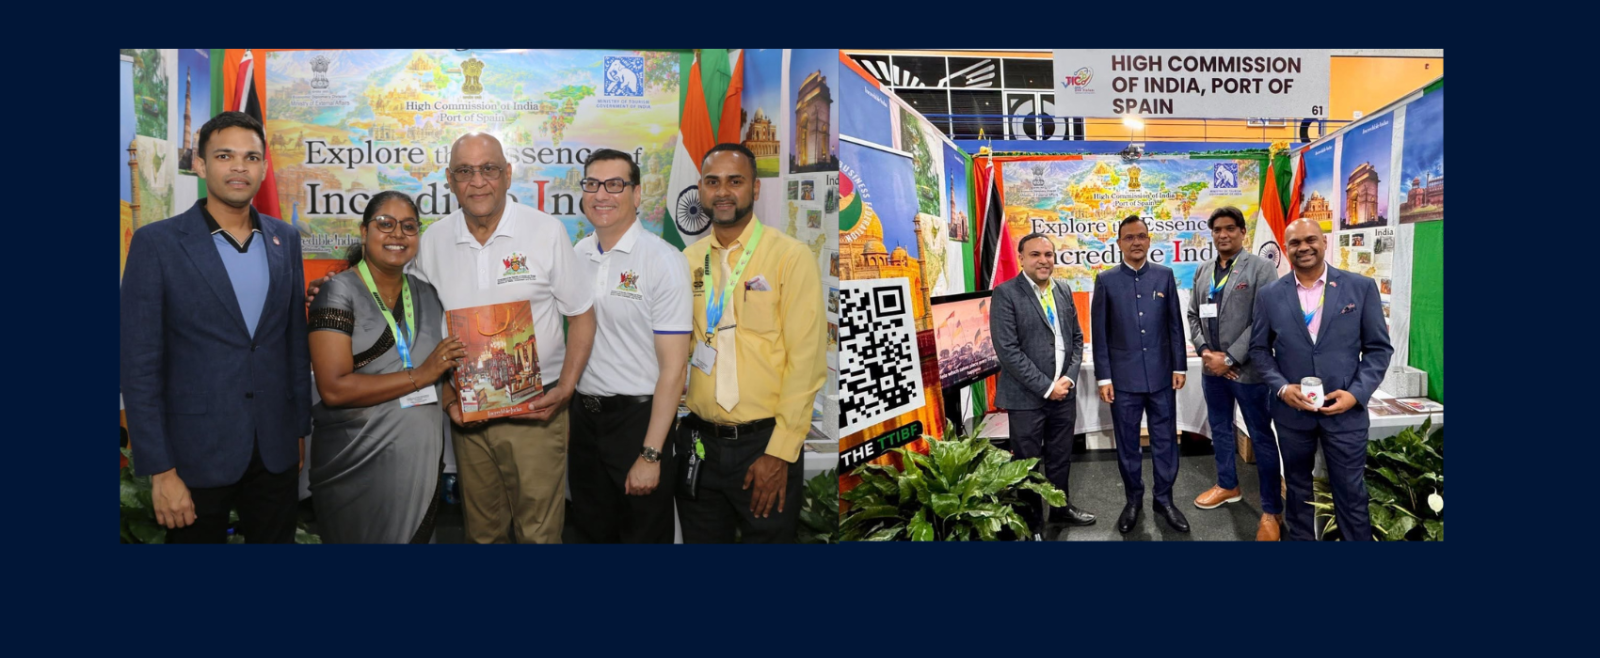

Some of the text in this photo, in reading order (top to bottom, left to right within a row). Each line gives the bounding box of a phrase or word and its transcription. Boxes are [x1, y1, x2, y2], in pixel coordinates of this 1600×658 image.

[1111, 55, 1301, 73] HIGH COMMISSION
[1112, 76, 1139, 93] OF
[1144, 77, 1206, 96] INDIA,
[1212, 78, 1264, 94] PORT
[1268, 78, 1294, 94] OF
[406, 102, 539, 112] High Commission of India
[1112, 98, 1173, 114] SPAIN
[1312, 106, 1323, 116] 61
[440, 113, 505, 124] Port of Spain
[305, 140, 424, 169] Explore
[435, 146, 451, 164] th
[505, 147, 592, 164] ssenc
[826, 174, 839, 186] Ind
[838, 160, 870, 198] BUSINESS
[844, 201, 872, 242] FEDERATION
[1031, 218, 1106, 236] Explore
[1141, 216, 1208, 232] Essenc
[1375, 228, 1394, 236] India
[1172, 240, 1213, 262] Ind
[840, 424, 917, 467] THE TTIBF
